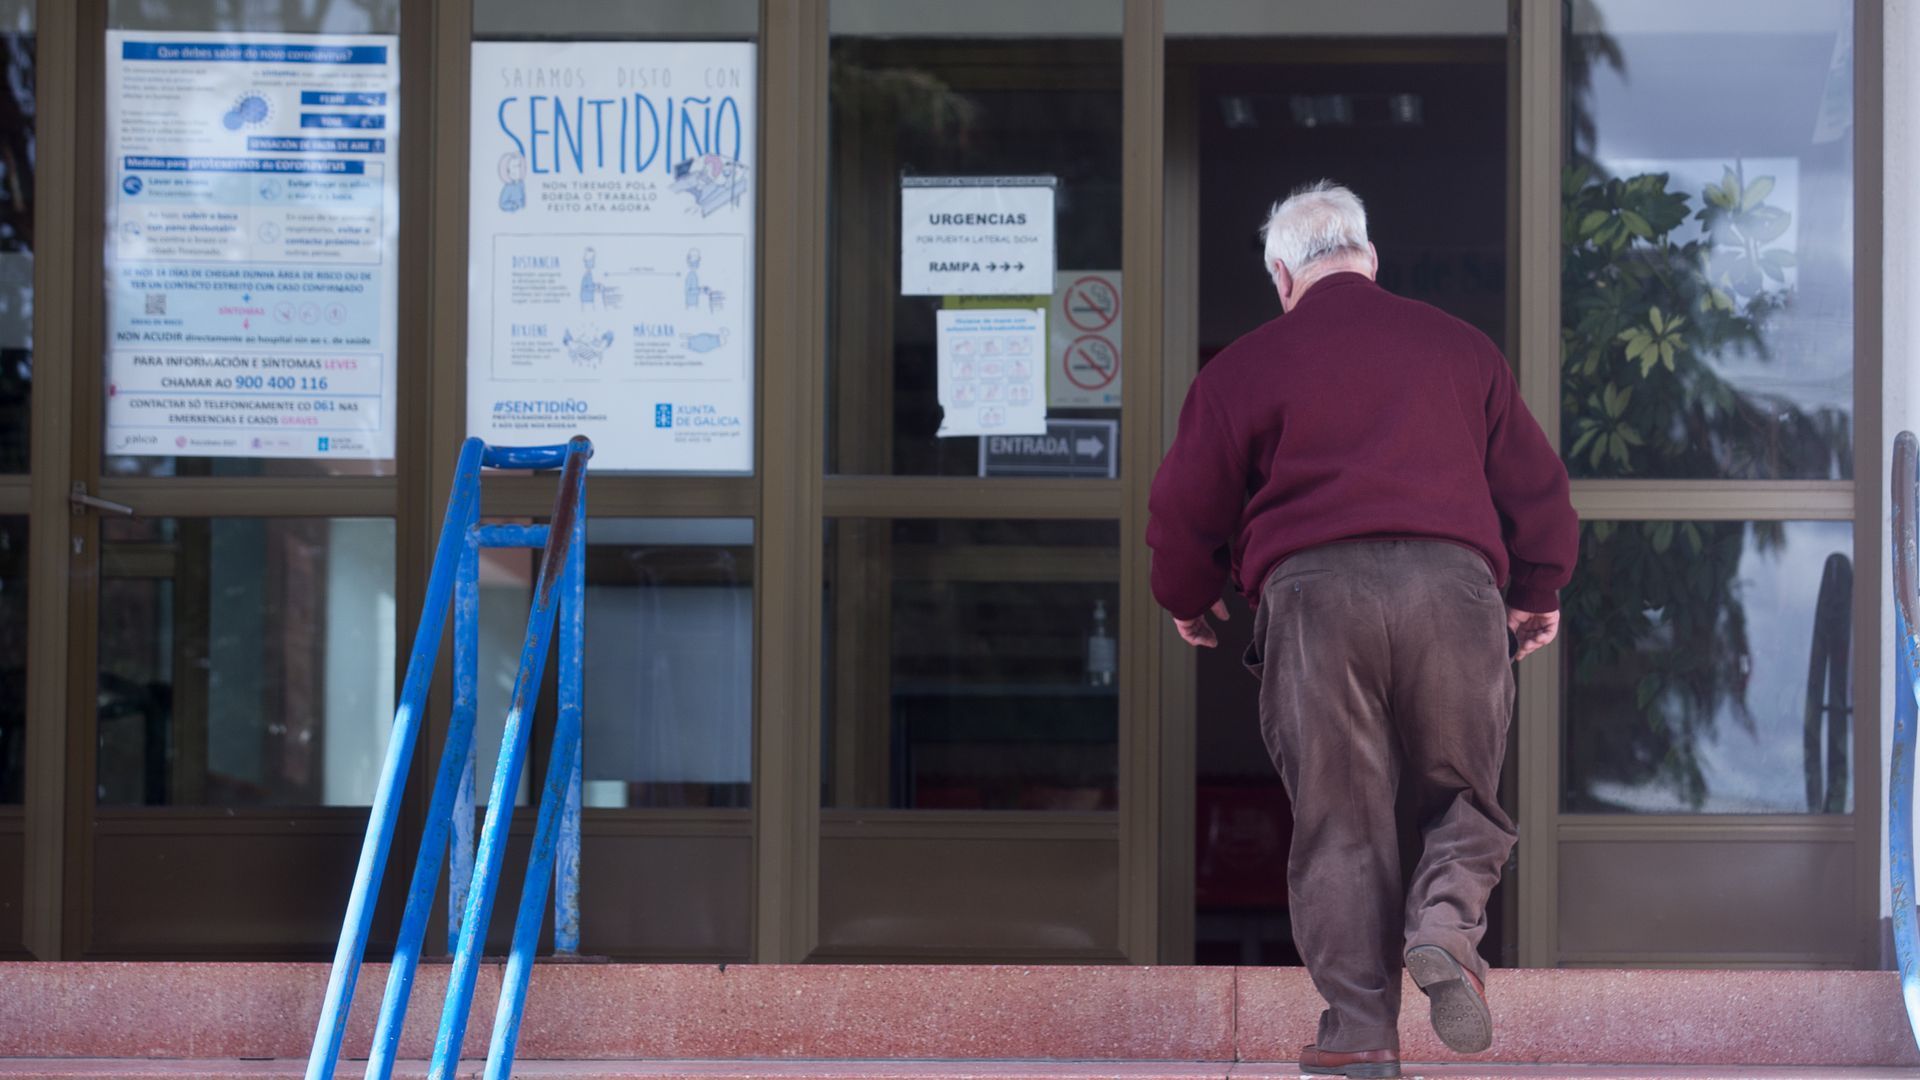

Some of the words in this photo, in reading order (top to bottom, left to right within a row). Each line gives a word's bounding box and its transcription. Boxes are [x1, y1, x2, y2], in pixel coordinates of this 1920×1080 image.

[501, 67, 585, 88] SAIAMOS
[618, 67, 672, 88] DISTO
[704, 67, 740, 88] CON
[498, 92, 741, 174] SENTIDIÑO
[189, 158, 261, 171] protexernos
[275, 160, 345, 172] coronavirus
[542, 180, 567, 190] NON
[572, 180, 621, 190] TIREMOS
[625, 180, 657, 190] POLA
[541, 191, 580, 201] BORDA
[583, 191, 592, 201] O
[597, 191, 657, 201] TRABALLO
[547, 203, 580, 212] FEITO
[585, 203, 605, 212] ATA
[611, 203, 651, 212] AGORA
[929, 213, 1026, 225] URGENCIAS
[916, 235, 933, 244] POR
[936, 235, 969, 244] PUERTA
[972, 235, 1010, 244] LATERAL
[929, 261, 980, 272] RAMPA
[117, 331, 140, 342] NON
[143, 332, 183, 342] ACUDIR
[133, 356, 163, 366] PARA
[165, 356, 250, 368] INFORMACIÓN
[252, 359, 259, 368] E
[324, 360, 358, 369] LEVES
[161, 377, 212, 388] CHAMAR
[215, 377, 233, 388] AO
[235, 375, 263, 389] 900
[267, 376, 296, 390] 400
[301, 376, 328, 391] 116
[130, 399, 186, 409] CONTACTAR
[203, 400, 295, 411] TELEFONICAMENTE
[297, 402, 312, 411] CO
[313, 401, 335, 412] 061
[339, 402, 359, 412] NAS
[493, 398, 588, 413] #SENTIDIÑO
[677, 404, 717, 415] XUNTA
[168, 413, 237, 424] EMERXENCIAS
[239, 415, 245, 424] E
[247, 415, 279, 425] CASOS
[676, 416, 689, 426] DE
[693, 416, 741, 426] GALICIA
[990, 436, 1070, 456] ENTRADA
